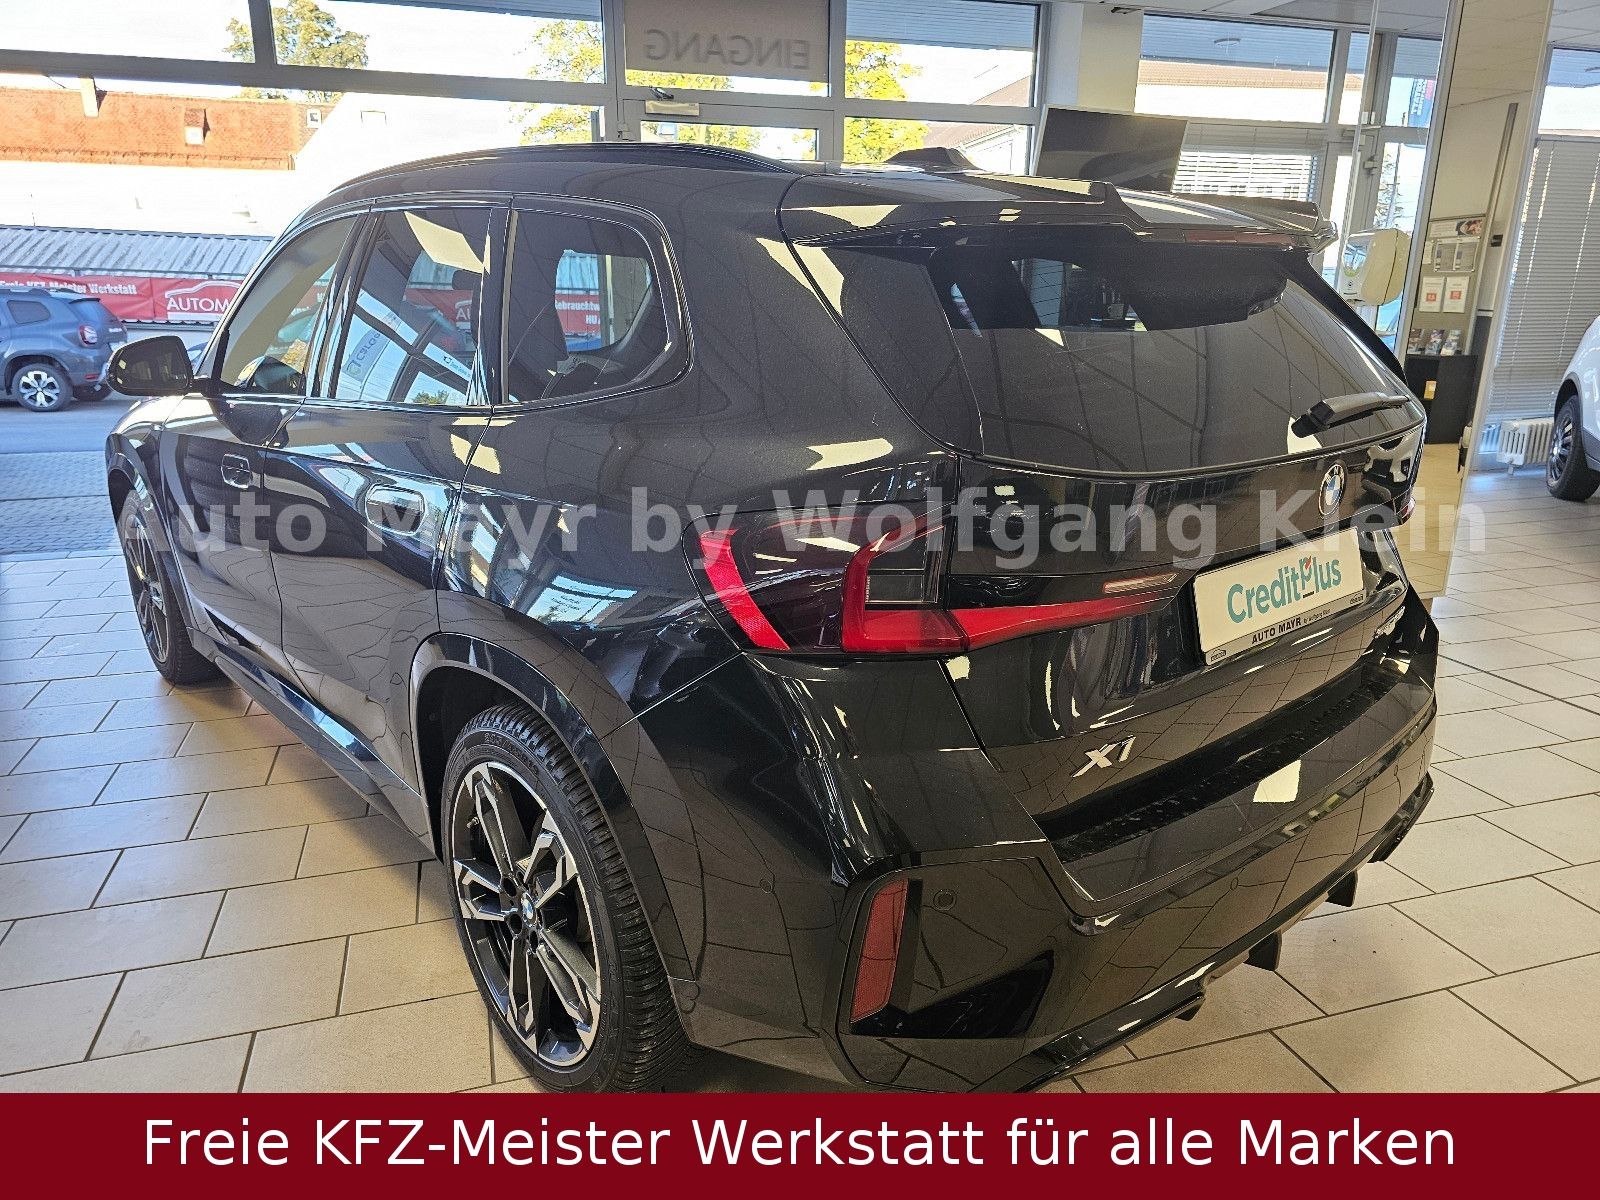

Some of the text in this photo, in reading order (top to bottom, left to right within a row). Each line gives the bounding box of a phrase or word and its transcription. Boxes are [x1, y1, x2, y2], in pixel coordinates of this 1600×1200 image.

[88, 283, 138, 295] Werkstatt
[1227, 556, 1342, 623] CreditPlus
[1251, 627, 1276, 645] AUTO
[1278, 617, 1302, 633] MAYR
[1070, 734, 1137, 778] X1
